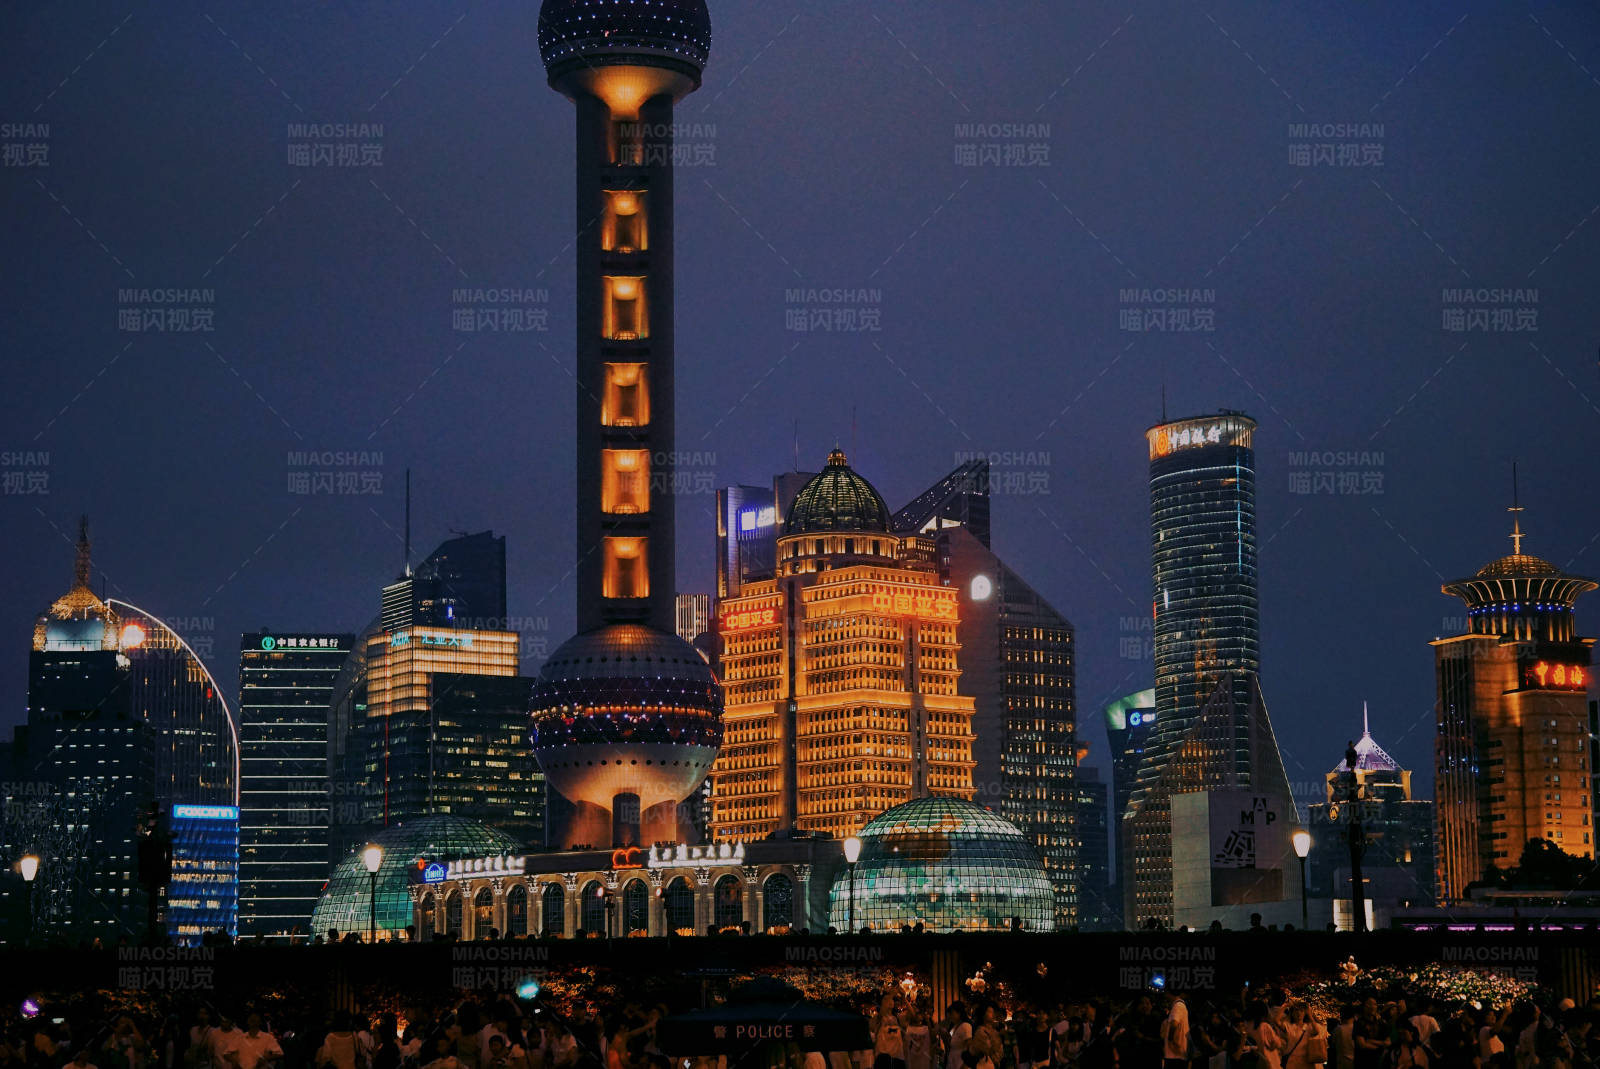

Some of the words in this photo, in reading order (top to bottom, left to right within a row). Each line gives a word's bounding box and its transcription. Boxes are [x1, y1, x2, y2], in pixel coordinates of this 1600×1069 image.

[872, 592, 954, 618] 中国平安
[725, 609, 775, 629] 中国平安
[276, 637, 339, 648] 中国农业银行
[736, 1024, 793, 1039] POLICE
